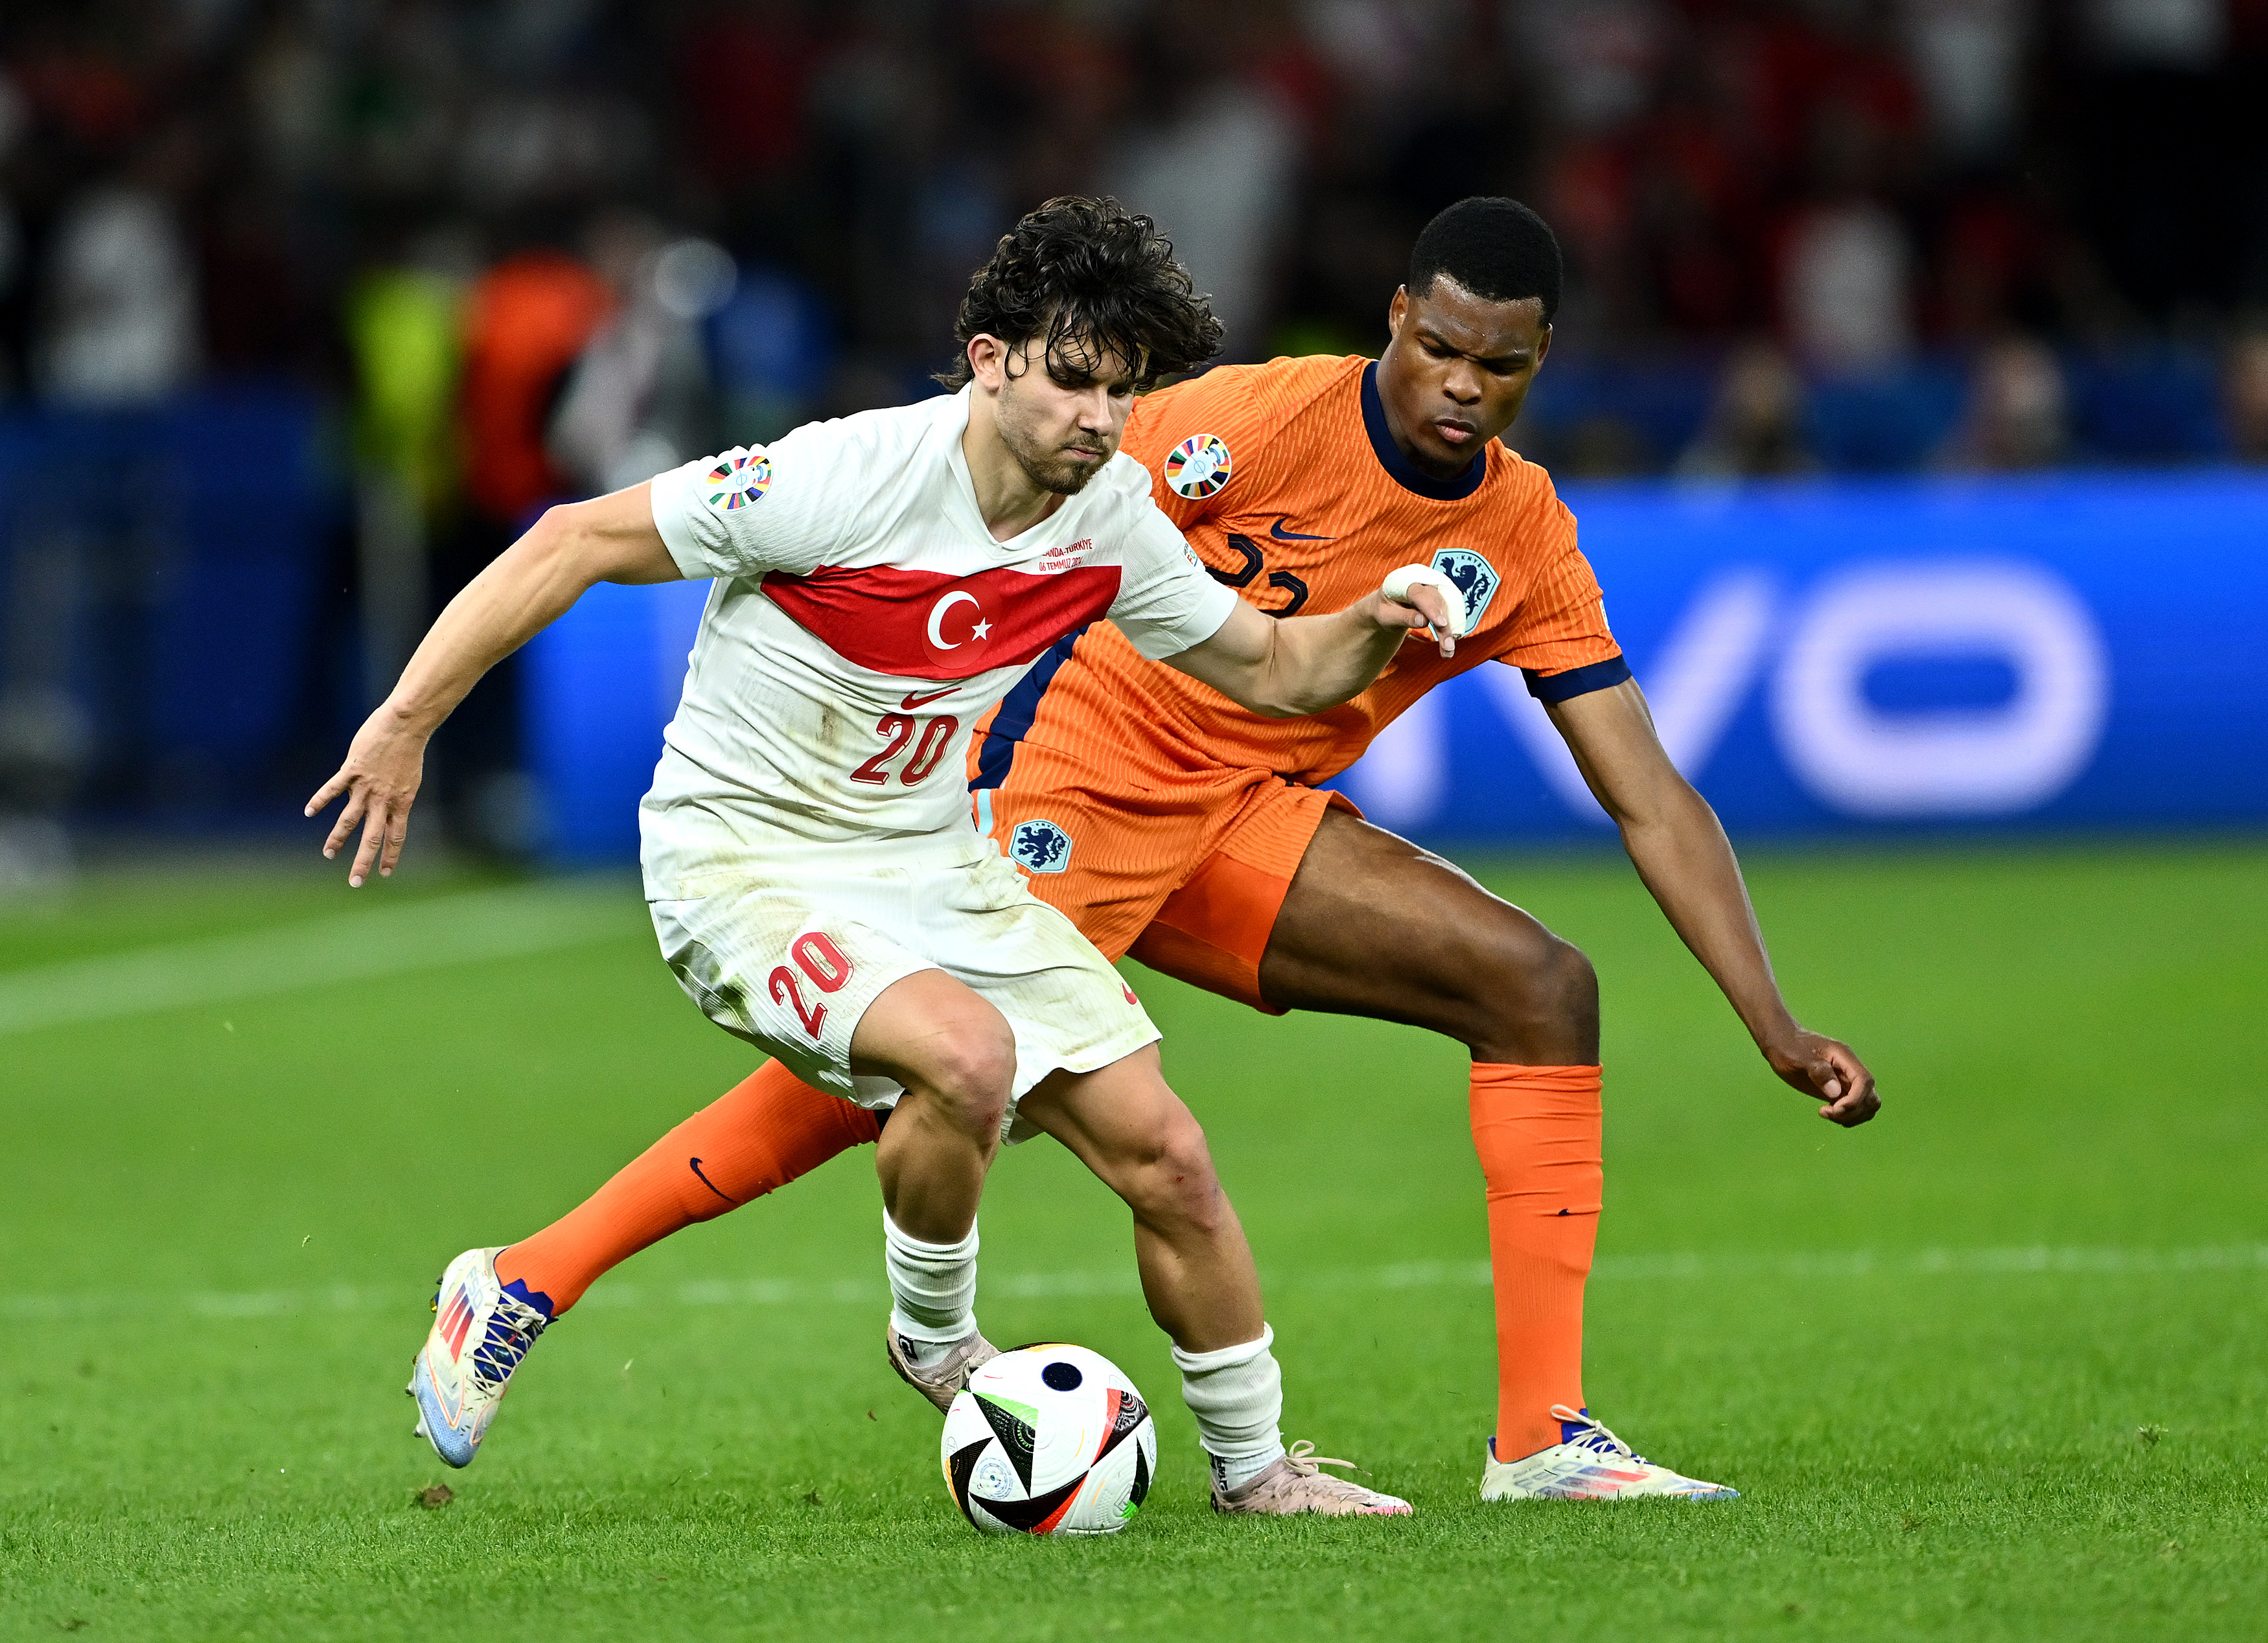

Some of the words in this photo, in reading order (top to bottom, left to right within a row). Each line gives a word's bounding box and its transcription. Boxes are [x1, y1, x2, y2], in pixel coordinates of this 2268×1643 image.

[1042, 538, 1093, 557] ANDA-TÜRKİYE
[1047, 558, 1071, 571] TEMMUZ
[850, 712, 959, 787] 20
[769, 932, 854, 1040] 20
